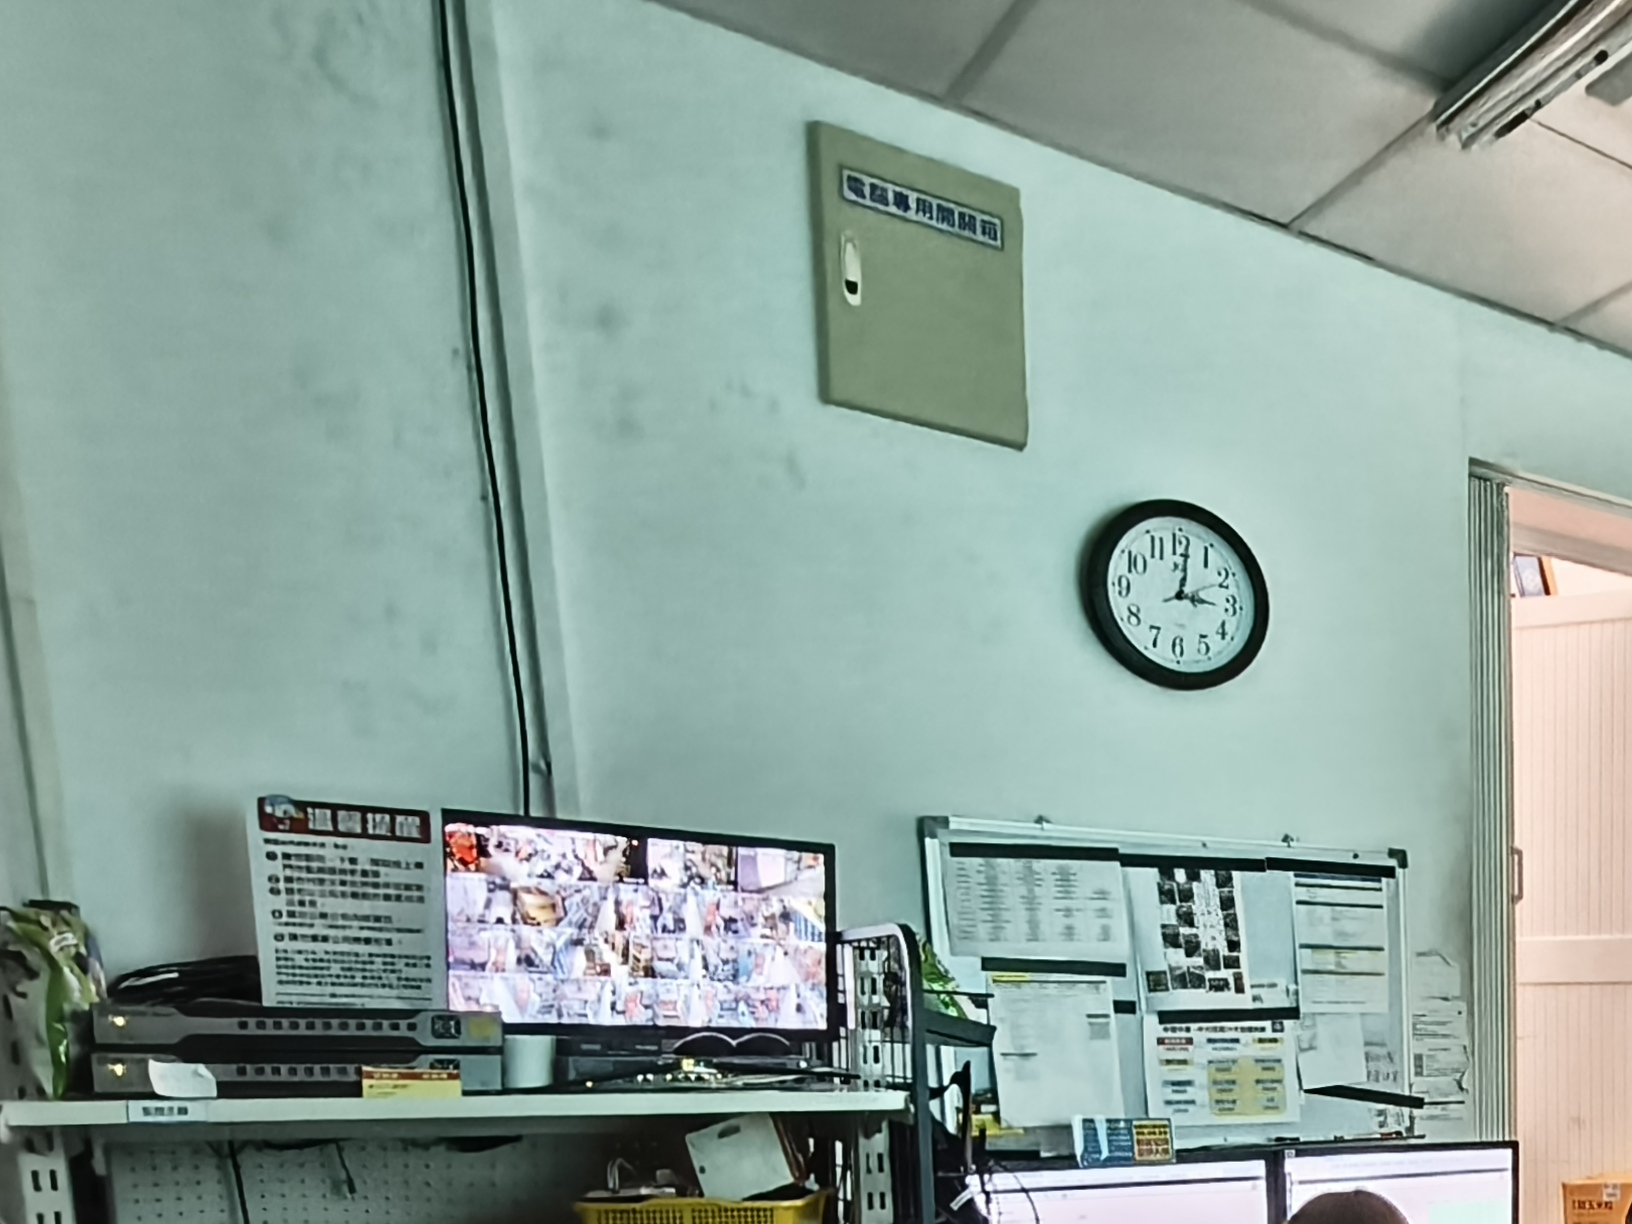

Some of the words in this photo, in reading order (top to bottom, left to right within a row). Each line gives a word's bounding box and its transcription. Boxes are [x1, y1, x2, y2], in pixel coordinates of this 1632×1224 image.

[1149, 535, 1164, 560] 11
[1172, 533, 1190, 558] 12
[1202, 545, 1209, 568] 1
[1127, 550, 1147, 575] 10
[1117, 574, 1131, 598] 9
[1217, 567, 1230, 589] 2
[1127, 603, 1141, 627] 8
[1224, 595, 1238, 617] 3
[1148, 625, 1161, 648] 7
[1216, 619, 1228, 641] 4
[1171, 636, 1184, 658] 6
[1198, 634, 1211, 656] 5
